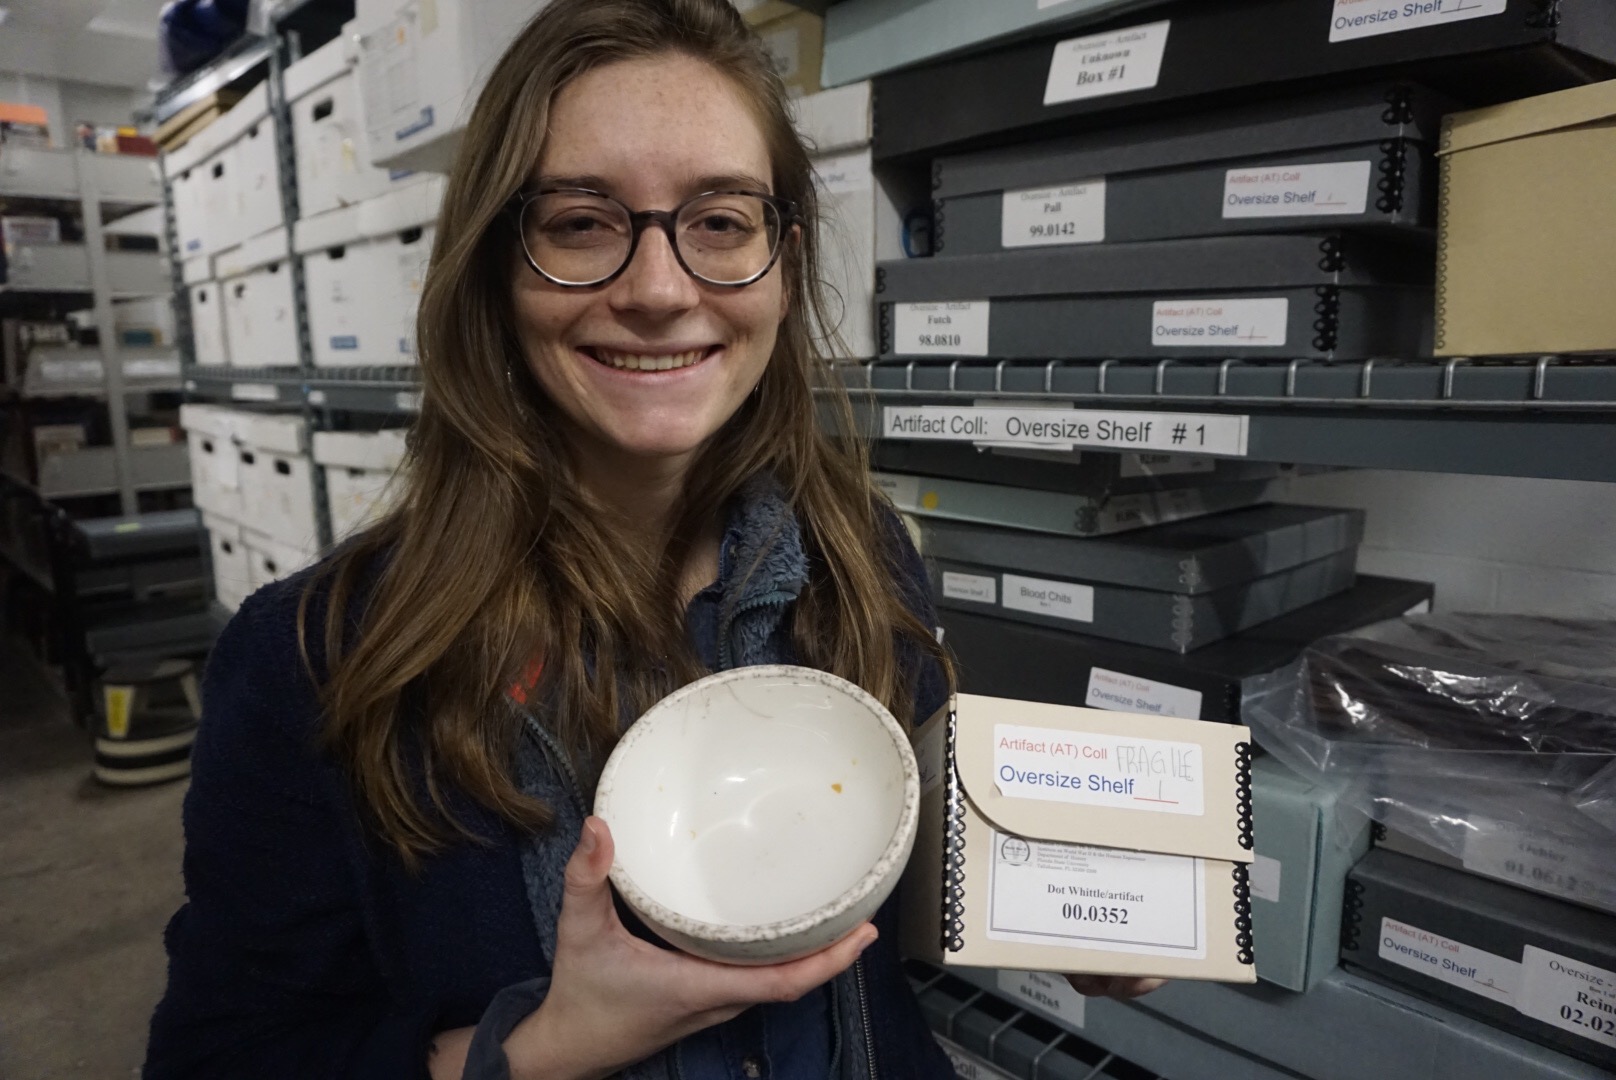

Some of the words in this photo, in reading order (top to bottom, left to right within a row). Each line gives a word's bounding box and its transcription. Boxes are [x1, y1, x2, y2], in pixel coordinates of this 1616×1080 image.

[1335, 9, 1398, 29] Oversize
[1403, 0, 1442, 18] Shelf
[1081, 49, 1130, 64] Unknown
[1076, 70, 1104, 86] Box
[1107, 64, 1126, 81] #1
[1229, 174, 1259, 184] Artifact
[1260, 173, 1280, 184] (AT)
[1282, 172, 1300, 182] Coll
[1228, 191, 1279, 206] Oversize
[1284, 190, 1316, 203] Shelf
[1029, 221, 1075, 238] 99.0142
[928, 315, 952, 324] Futch
[1156, 308, 1184, 316] Artifact
[1186, 308, 1204, 317] (AT)
[1206, 307, 1223, 316] Coll
[919, 334, 961, 346] 98.0810
[1156, 325, 1205, 336] Oversize
[1208, 325, 1239, 336] Shelf
[891, 414, 946, 433] Artifact
[950, 415, 989, 435] Coll:
[1005, 416, 1090, 440] Oversize
[1096, 419, 1153, 442] Shelf
[1020, 586, 1046, 601] Blood
[1048, 590, 1072, 604] Chits
[1094, 673, 1118, 684] Artifact
[1091, 688, 1133, 706] Oversize
[1136, 698, 1162, 713] Shelf
[999, 737, 1046, 754] Artifact
[1050, 742, 1079, 760] (AT)
[1082, 745, 1108, 760] Coll
[1116, 745, 1194, 782] FRAGILE
[999, 765, 1082, 790] Oversize
[1087, 774, 1135, 795] Shelf
[1047, 884, 1065, 896] Dot
[1068, 885, 1144, 903] Whittle/artifact
[1062, 902, 1129, 925] 00.0352
[1384, 920, 1417, 940] Artifact
[1417, 931, 1439, 948] (AT)
[1440, 938, 1460, 954] Coll
[1383, 936, 1438, 966] Oversize
[1441, 958, 1477, 980] Shelf
[1549, 960, 1604, 986] Oversize
